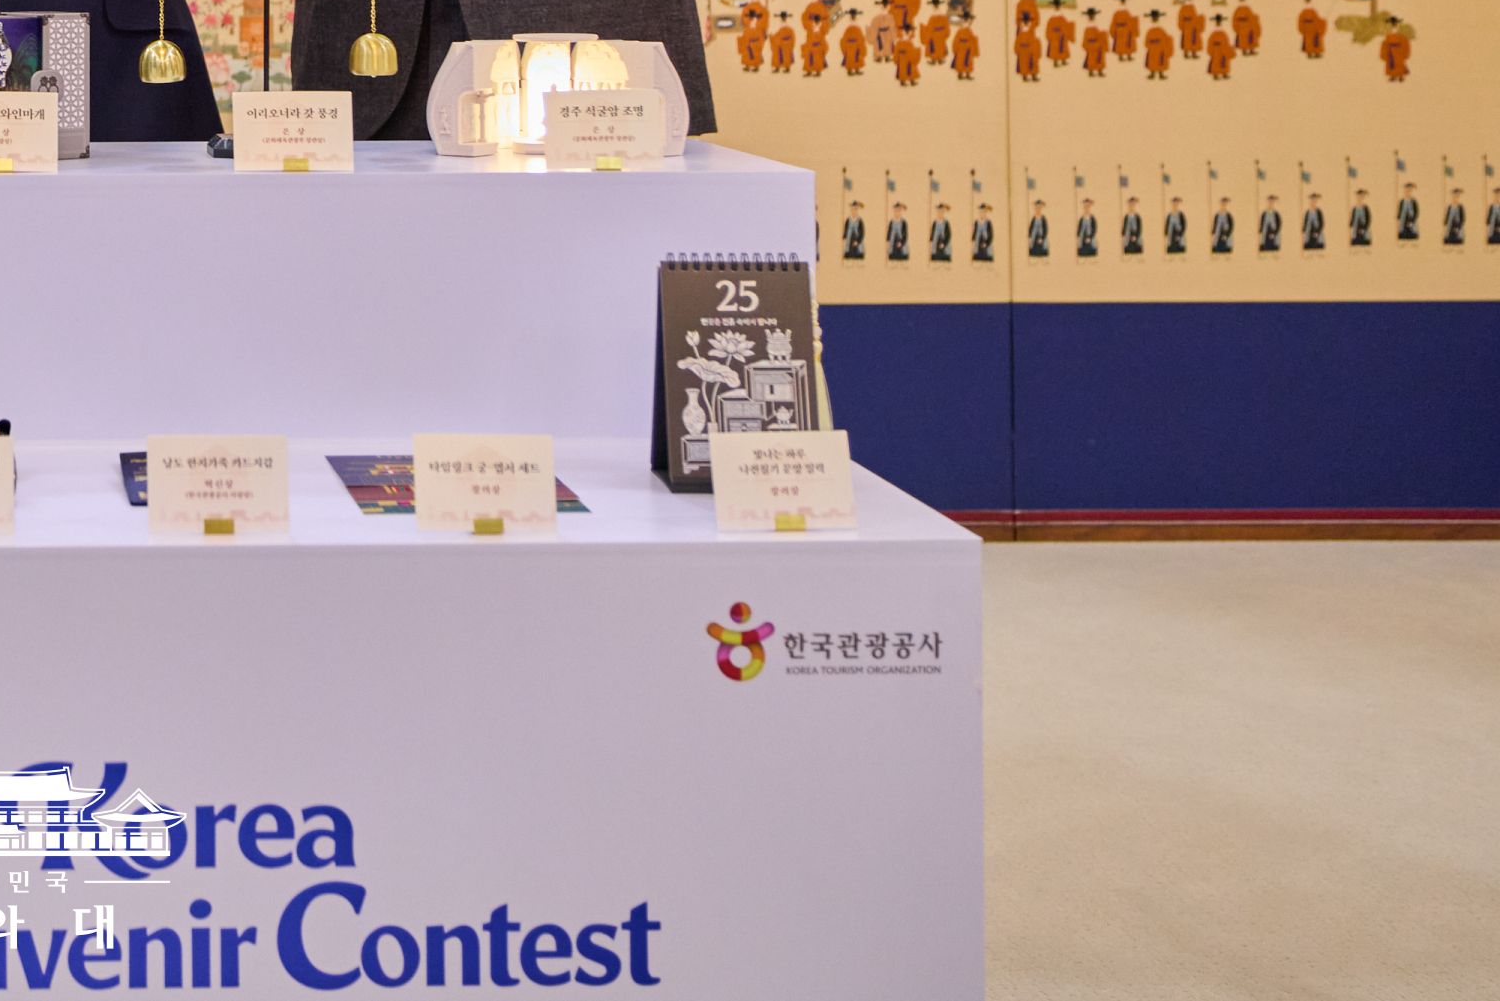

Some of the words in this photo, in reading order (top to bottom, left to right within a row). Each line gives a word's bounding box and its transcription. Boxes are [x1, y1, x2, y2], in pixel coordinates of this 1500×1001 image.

[0, 108, 45, 120] 와인마개
[246, 108, 301, 119] 이리오너라
[303, 108, 314, 118] 갓
[318, 108, 338, 119] 풍경
[559, 106, 582, 118] 경주
[585, 105, 620, 117] 석굴암
[623, 105, 644, 116] 조명
[716, 280, 759, 312] 25
[162, 458, 184, 468] 남도
[231, 457, 274, 468] 카드지갑
[784, 632, 942, 659] 한국관광공사
[786, 666, 818, 675] KOREA
[821, 666, 863, 674] TOURISM
[867, 665, 941, 674] ORGANIZATION
[278, 882, 660, 990] Contest
